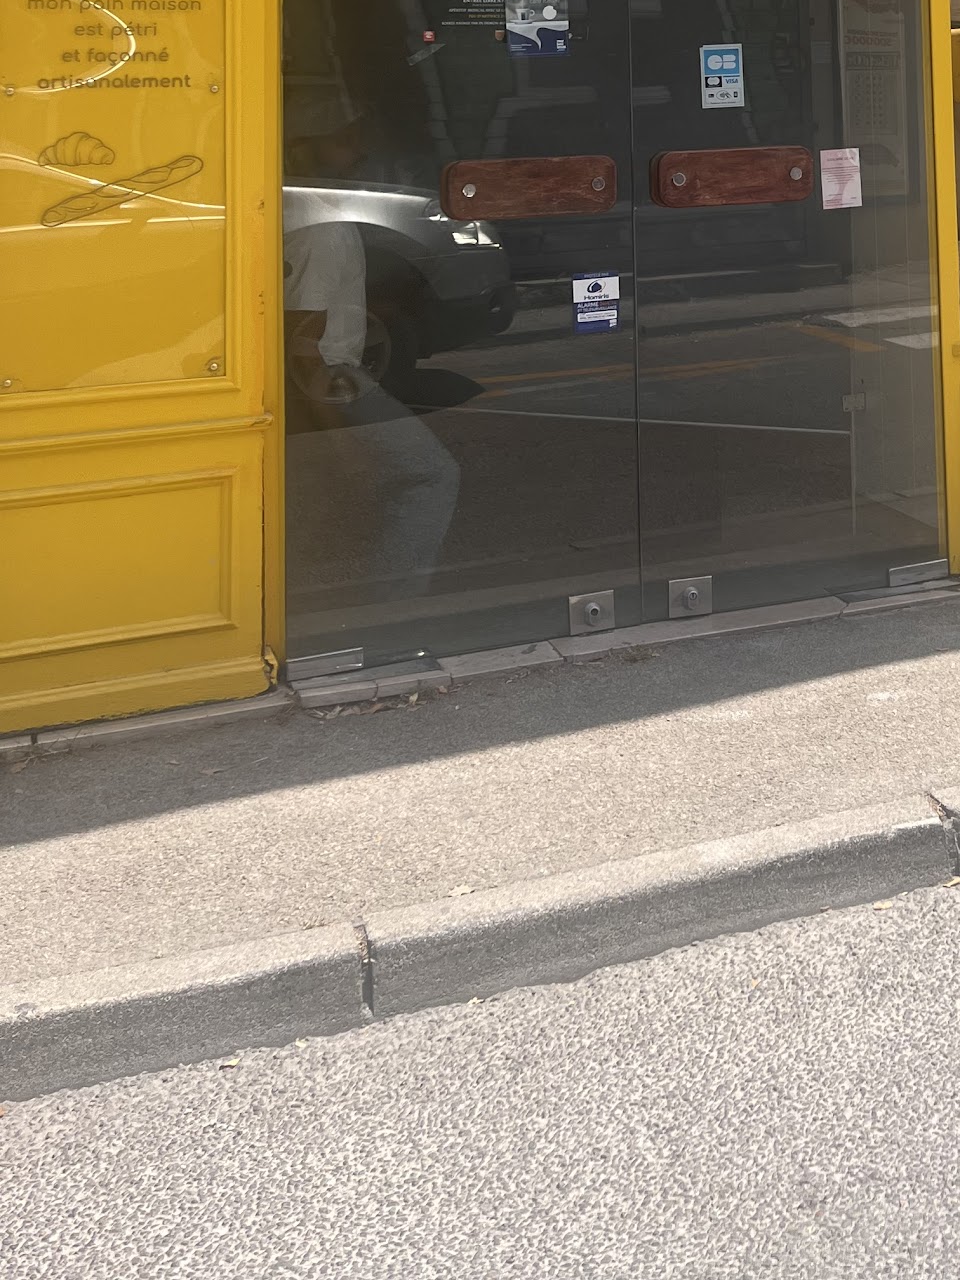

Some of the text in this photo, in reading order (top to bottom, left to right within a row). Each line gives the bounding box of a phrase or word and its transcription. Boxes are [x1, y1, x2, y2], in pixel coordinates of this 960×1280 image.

[27, 0, 72, 11] mon
[74, 22, 157, 40] est pétri
[61, 48, 169, 66] et façonné
[37, 74, 191, 90] artisanalement
